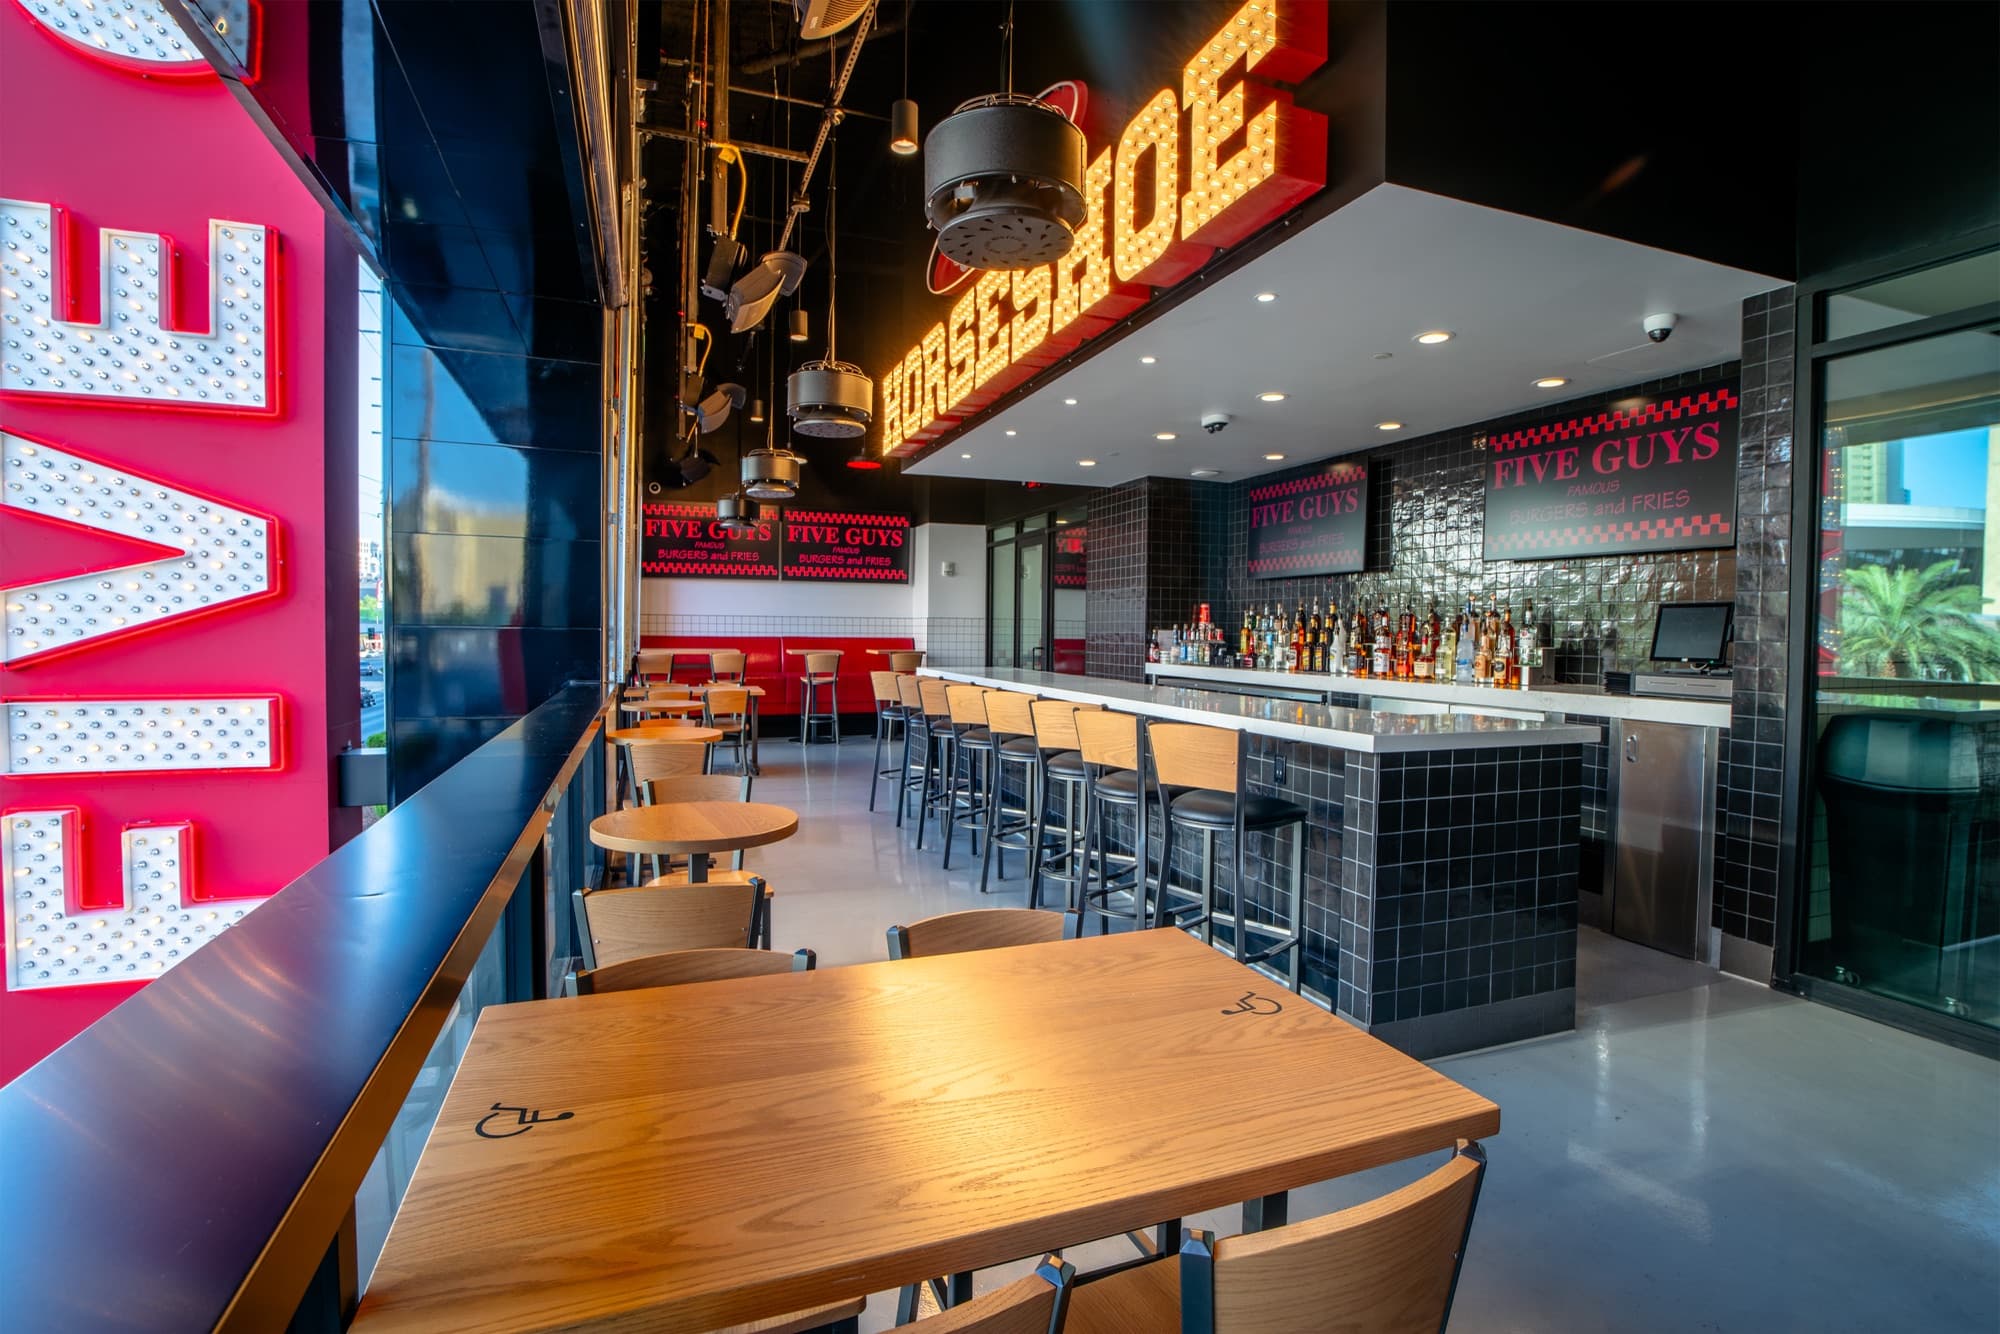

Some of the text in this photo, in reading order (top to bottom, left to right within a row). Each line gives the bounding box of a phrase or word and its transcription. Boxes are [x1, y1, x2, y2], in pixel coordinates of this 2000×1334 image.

[882, 0, 1278, 457] HORSESHOE
[1492, 420, 1721, 490] FIVE GUYS
[1567, 480, 1621, 497] FAMOUS
[1251, 487, 1359, 529] FIVE GUYS
[1509, 489, 1691, 525] BURGERS and FRIES
[645, 518, 703, 539] FIVE
[787, 524, 904, 547] FIVE GUYS
[657, 549, 760, 561] BURGERS and FRIES
[798, 554, 845, 565] BURGERS
[865, 556, 892, 567] FRIES
[0, 200, 270, 992] FIVE
